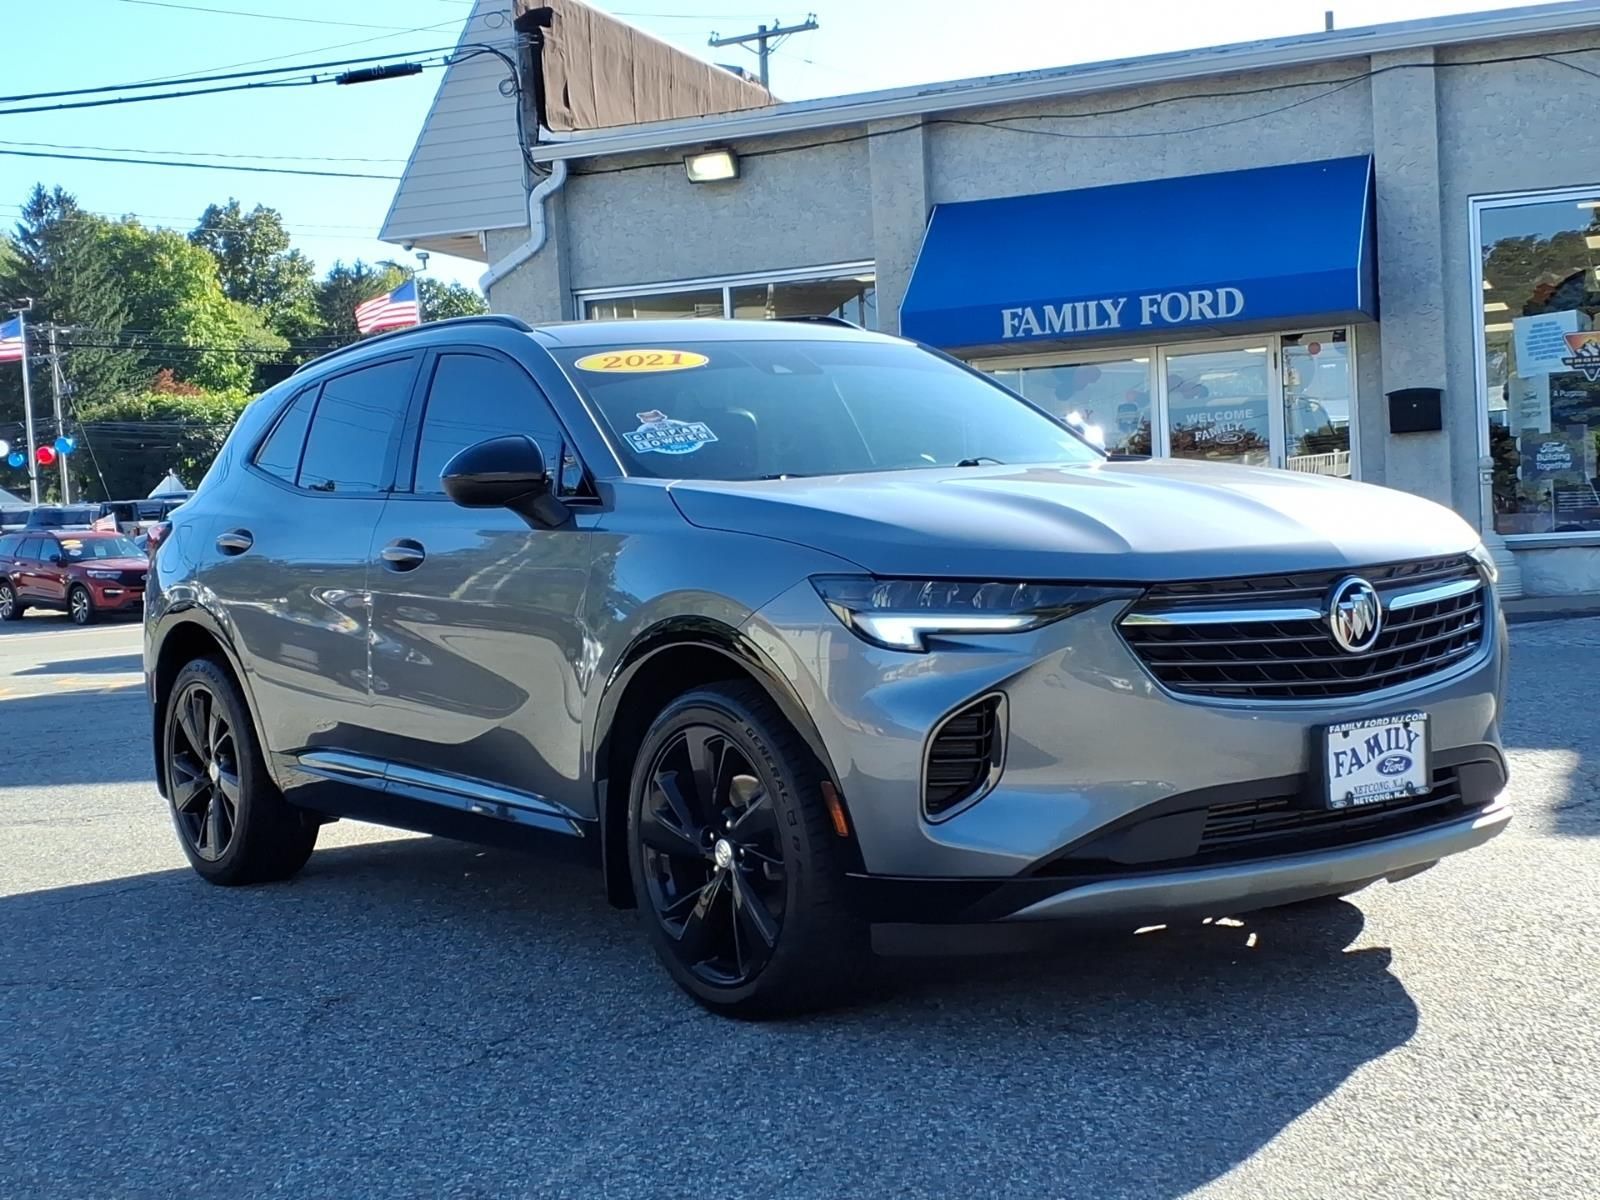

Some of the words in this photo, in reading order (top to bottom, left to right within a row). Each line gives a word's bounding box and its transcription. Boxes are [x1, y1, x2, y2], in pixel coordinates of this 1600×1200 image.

[1001, 297, 1127, 338] FAMILY
[1139, 287, 1245, 325] FORD
[603, 353, 683, 369] 2021
[1186, 408, 1254, 424] WELCOME
[633, 425, 706, 441] CARFAX
[1195, 421, 1243, 441] FAMILY
[651, 433, 708, 446] OWNER
[1536, 453, 1571, 462] Building
[1536, 462, 1572, 471] Together
[1329, 721, 1363, 733] FAMILY
[1364, 718, 1389, 728] FORD
[1333, 727, 1420, 778] FAMILY
[745, 727, 789, 804] GENERAL
[1382, 757, 1405, 773] Ford
